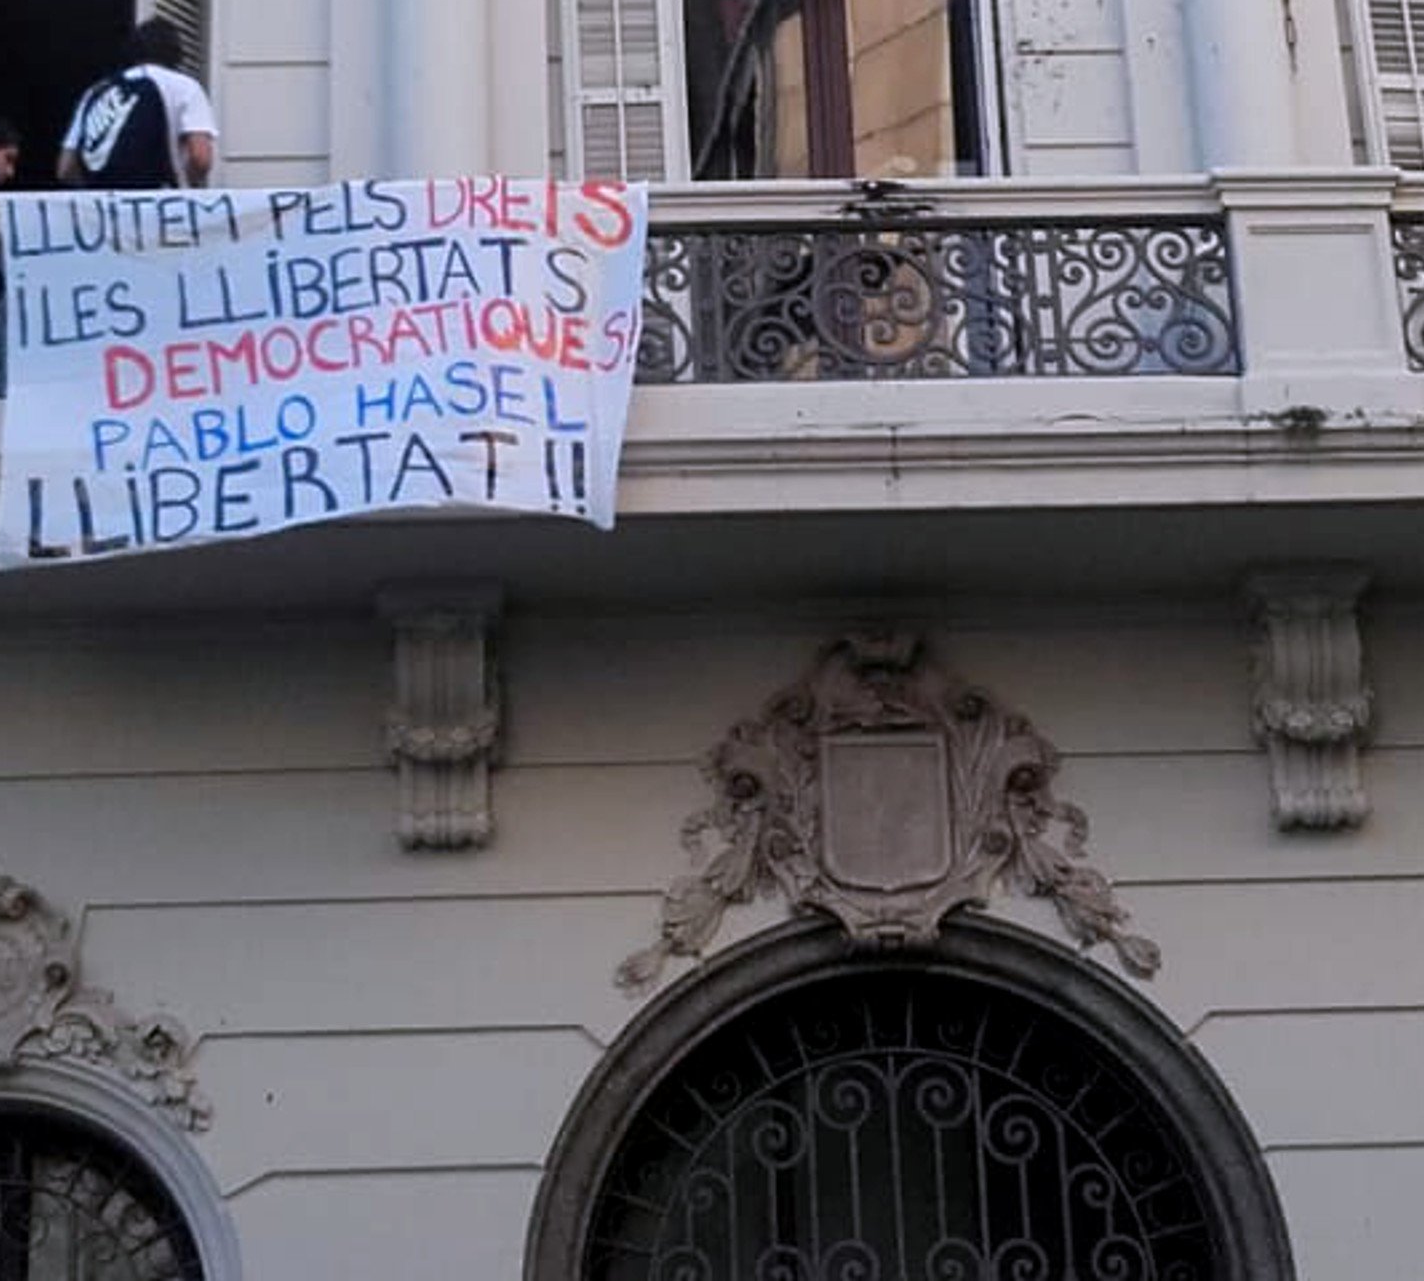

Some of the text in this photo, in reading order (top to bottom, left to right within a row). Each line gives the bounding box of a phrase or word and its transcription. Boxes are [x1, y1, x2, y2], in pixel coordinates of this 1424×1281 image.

[269, 180, 406, 240] PELS
[92, 361, 588, 470] PABLO HASEL
